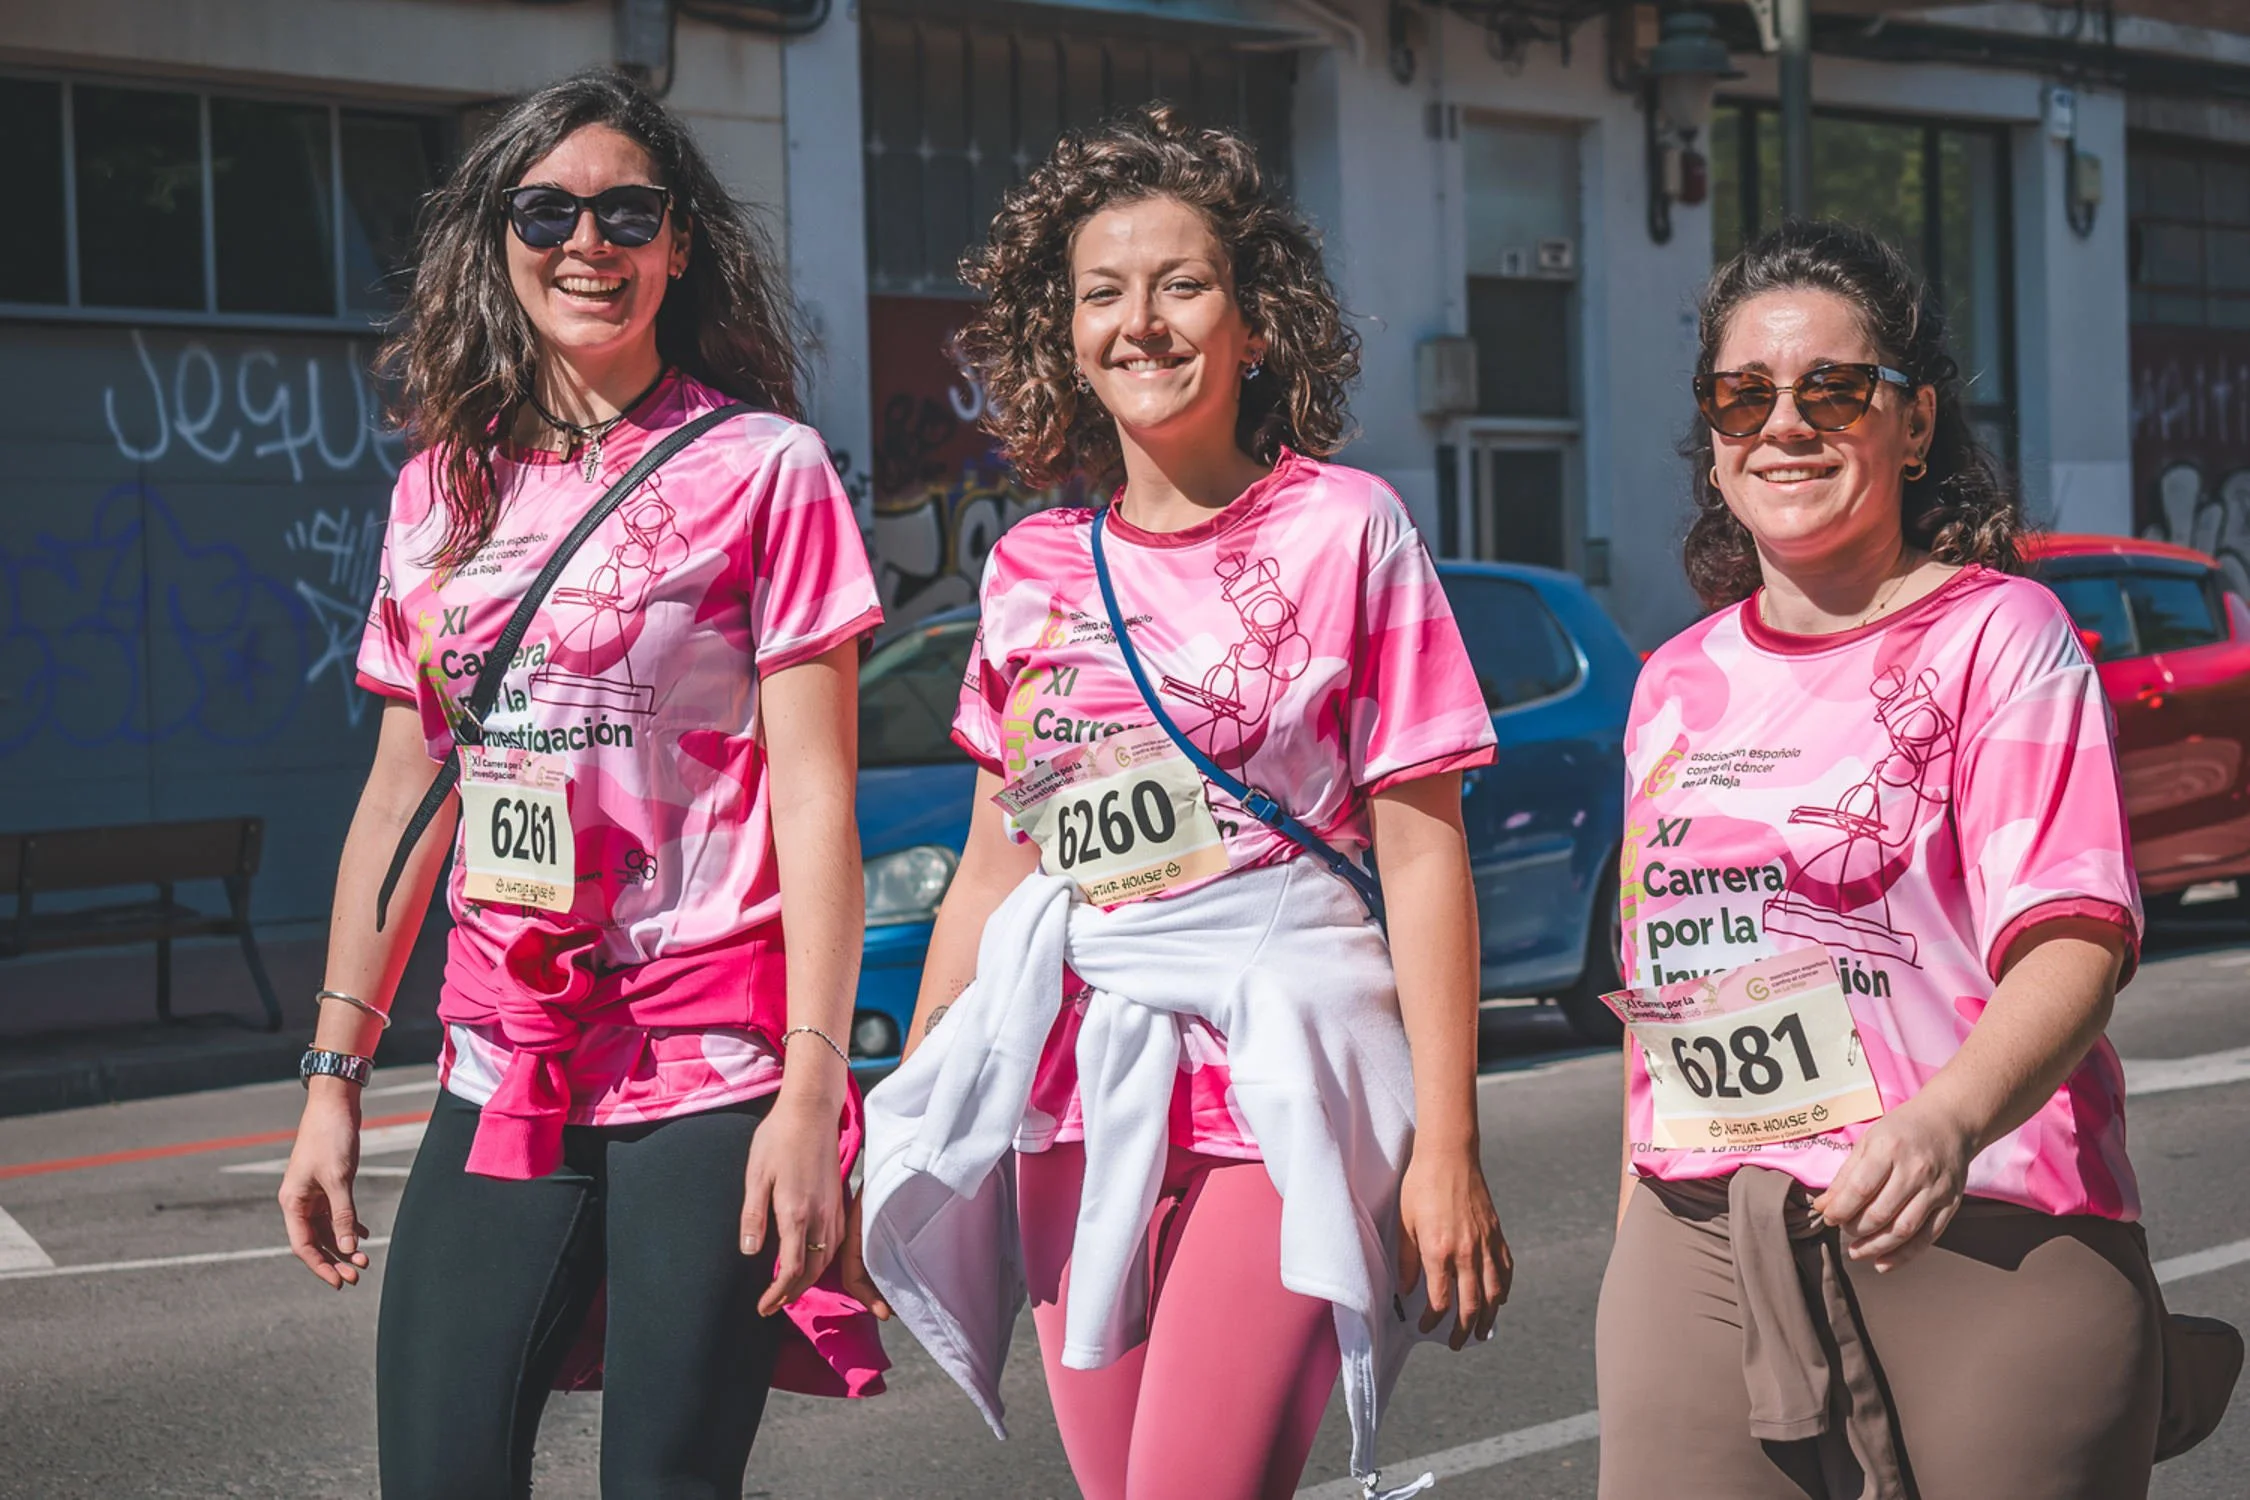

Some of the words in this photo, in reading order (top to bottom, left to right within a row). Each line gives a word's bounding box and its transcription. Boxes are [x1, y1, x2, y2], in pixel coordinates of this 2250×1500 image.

[439, 606, 468, 638] XI
[440, 642, 546, 680] Caera
[1043, 666, 1079, 697] XI
[504, 682, 527, 713] la
[484, 715, 633, 754] nvestigación
[1033, 708, 1142, 743] Carre
[1733, 761, 1775, 773] cáncer
[1749, 748, 1801, 761] española
[1010, 788, 1026, 800] XI
[1026, 771, 1060, 792] Carrera
[1709, 774, 1741, 789] Rioja
[491, 797, 557, 866] 6261
[1058, 779, 1176, 870] 6260
[1646, 818, 1692, 848] XI
[1121, 869, 1162, 890] HOUSE
[1643, 861, 1785, 899] Carrera
[1646, 914, 1713, 960] por
[1721, 907, 1758, 945] la
[1666, 1000, 1682, 1010] por
[1683, 996, 1695, 1005] la
[1671, 1012, 1820, 1098] 6281
[1763, 1113, 1808, 1132] HOUSE
